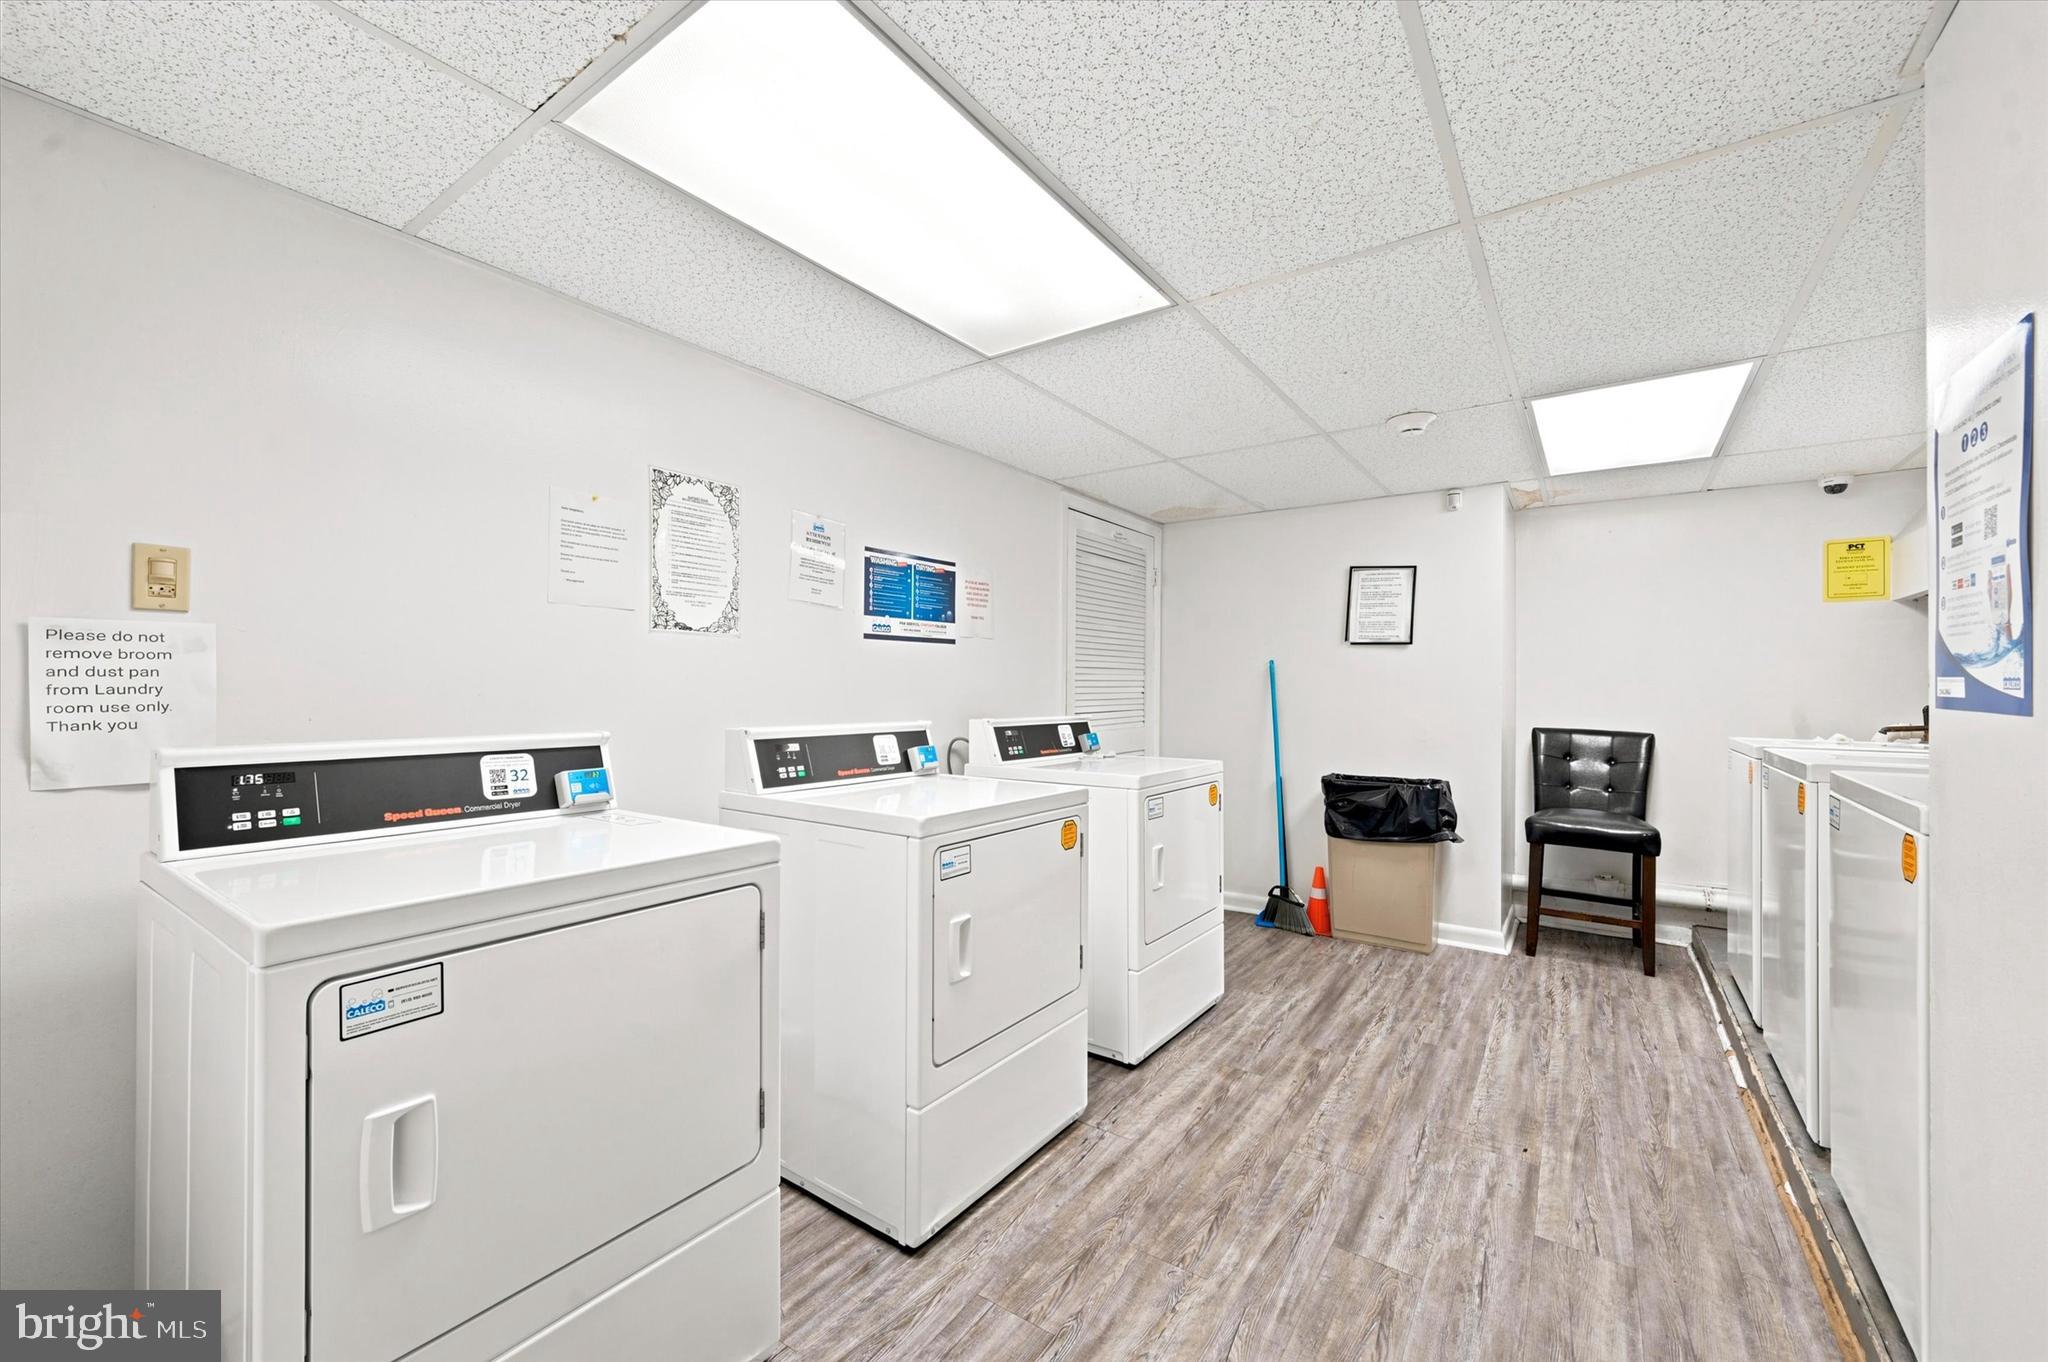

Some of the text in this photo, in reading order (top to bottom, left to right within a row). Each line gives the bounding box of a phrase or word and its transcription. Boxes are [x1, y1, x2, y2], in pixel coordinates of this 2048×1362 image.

[46, 629, 165, 643] Please do not
[46, 648, 172, 660] remove broom
[46, 666, 159, 680] and dust pan
[46, 683, 163, 697] from Laundry
[46, 701, 173, 715] room use only.
[46, 720, 138, 733] Thank you
[510, 768, 529, 782] 32
[384, 801, 521, 821] Speed Queen Commercial Dryer
[347, 1002, 385, 1018] CALECO
